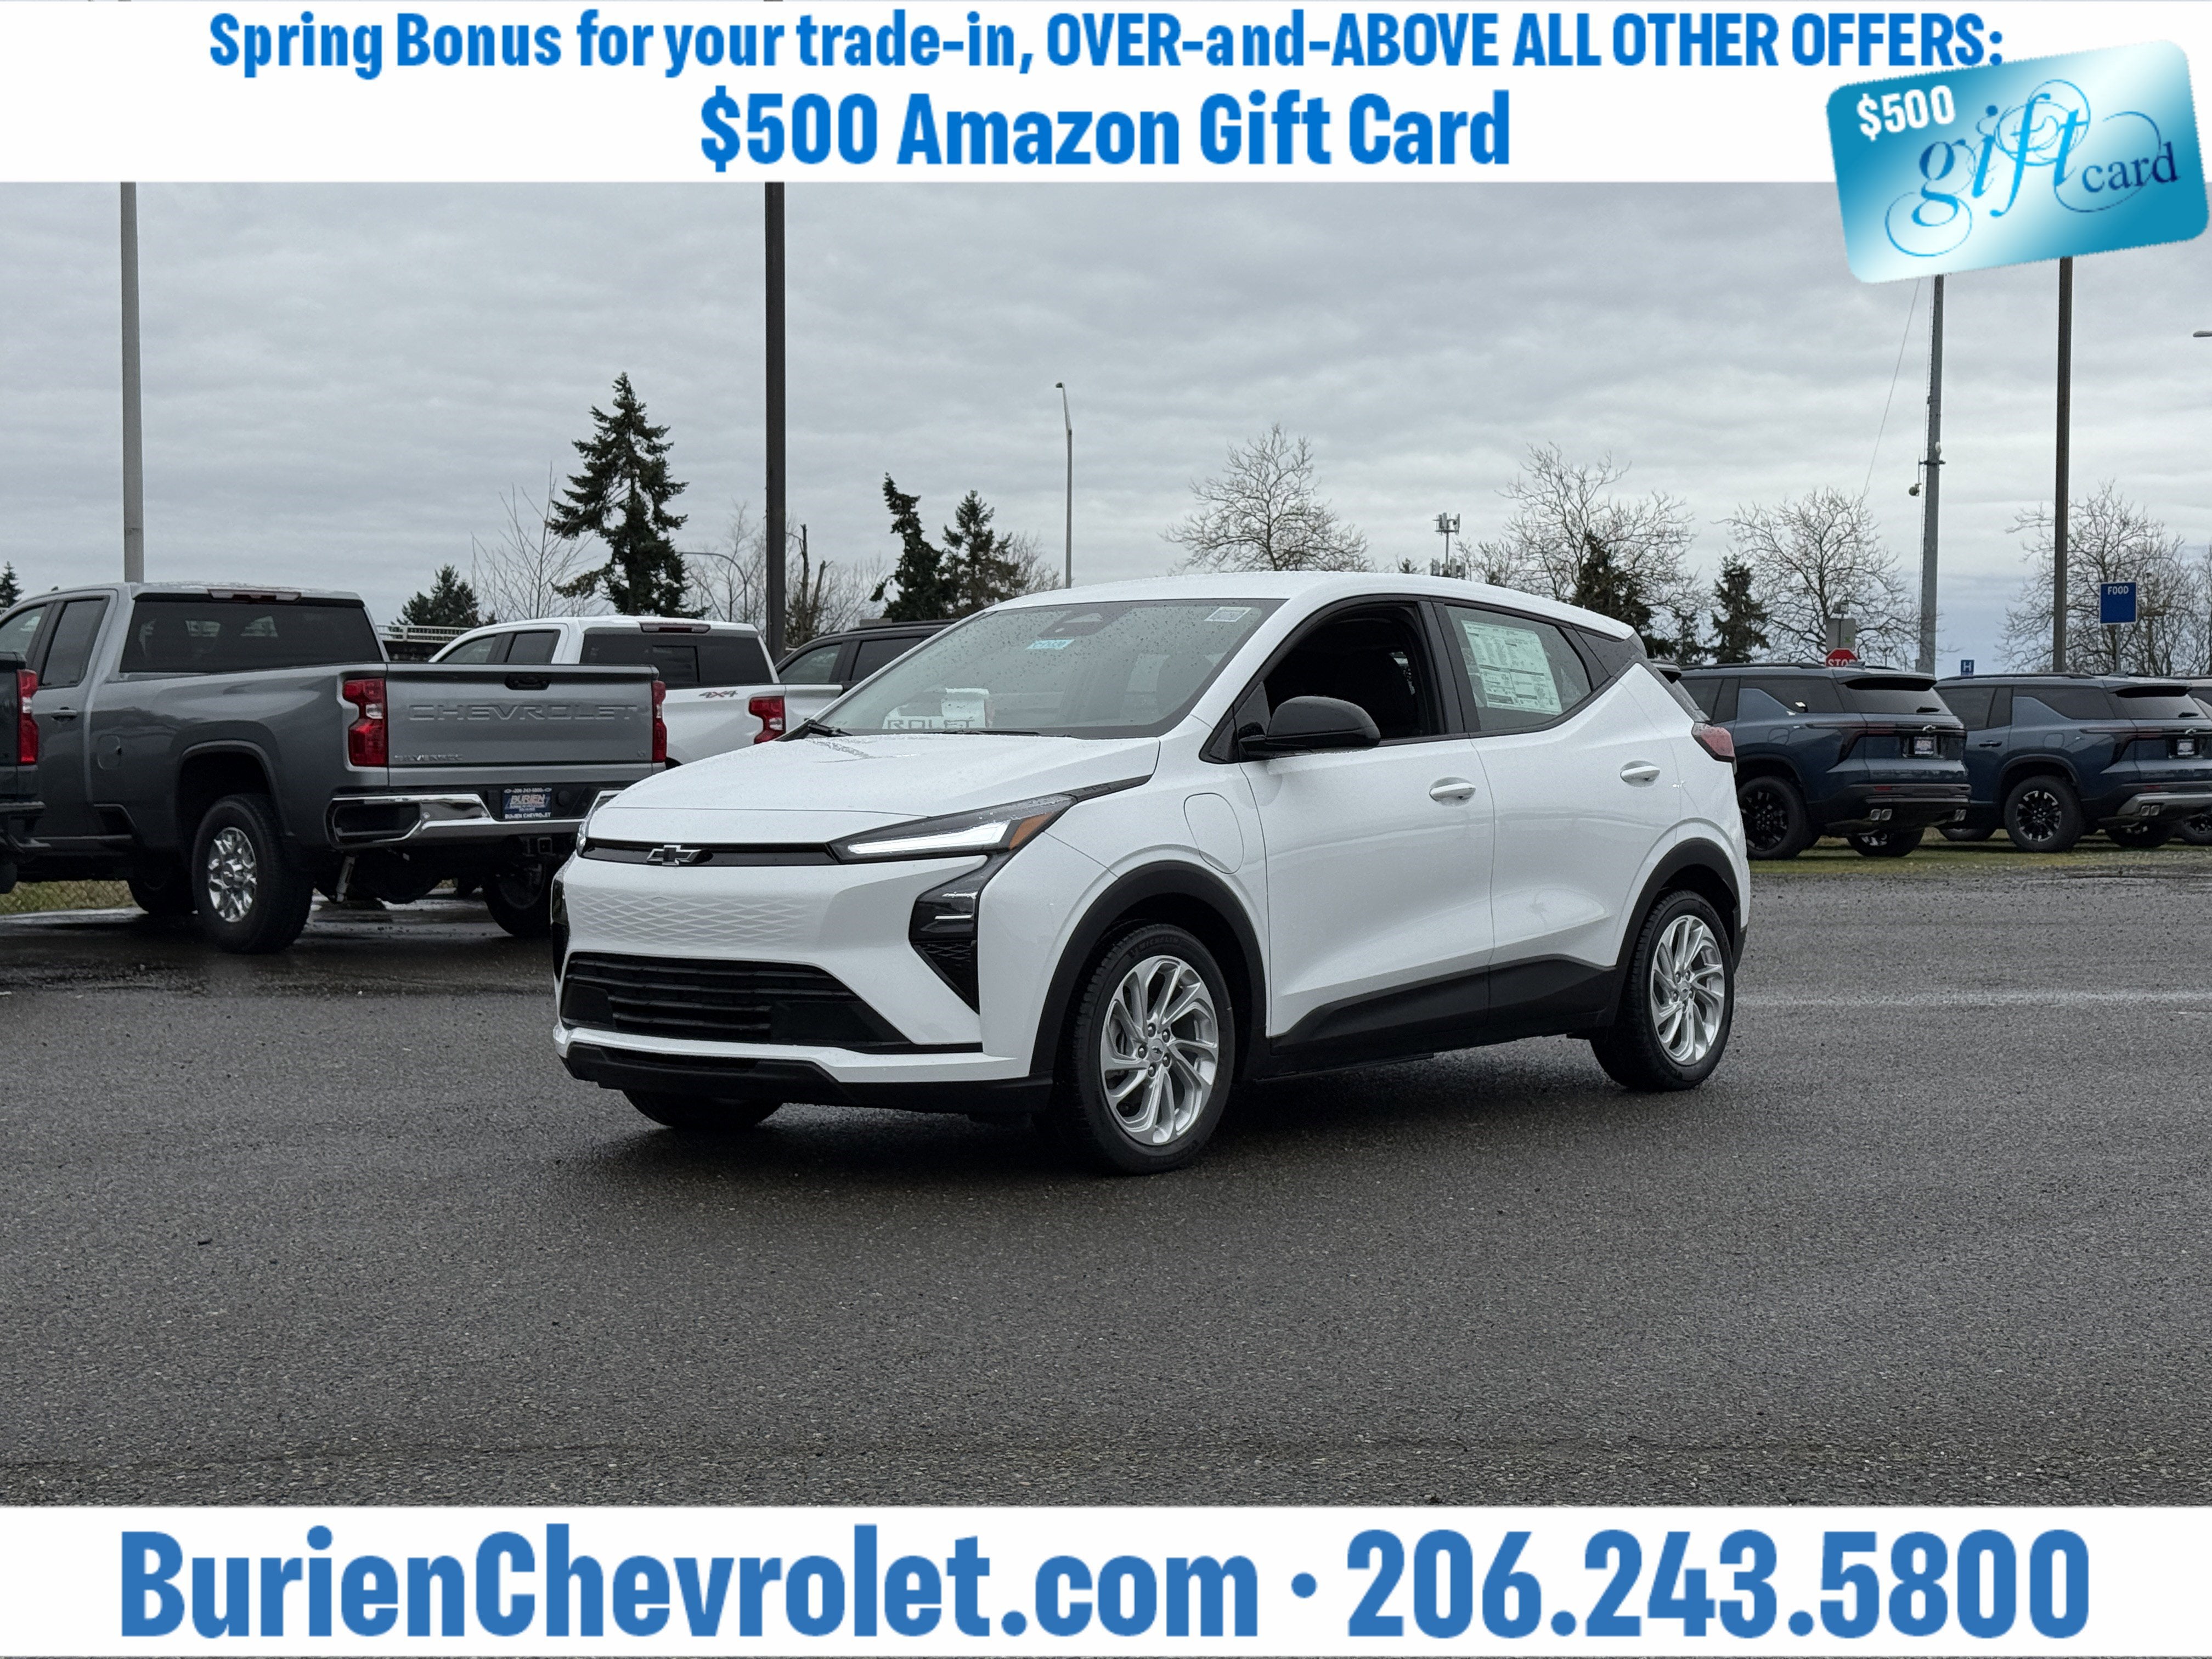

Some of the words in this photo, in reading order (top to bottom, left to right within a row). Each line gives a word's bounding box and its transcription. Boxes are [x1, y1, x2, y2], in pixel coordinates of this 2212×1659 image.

[2108, 585, 2129, 596] FOOD
[1963, 661, 1972, 672] H
[409, 704, 639, 721] CHEVROLET
